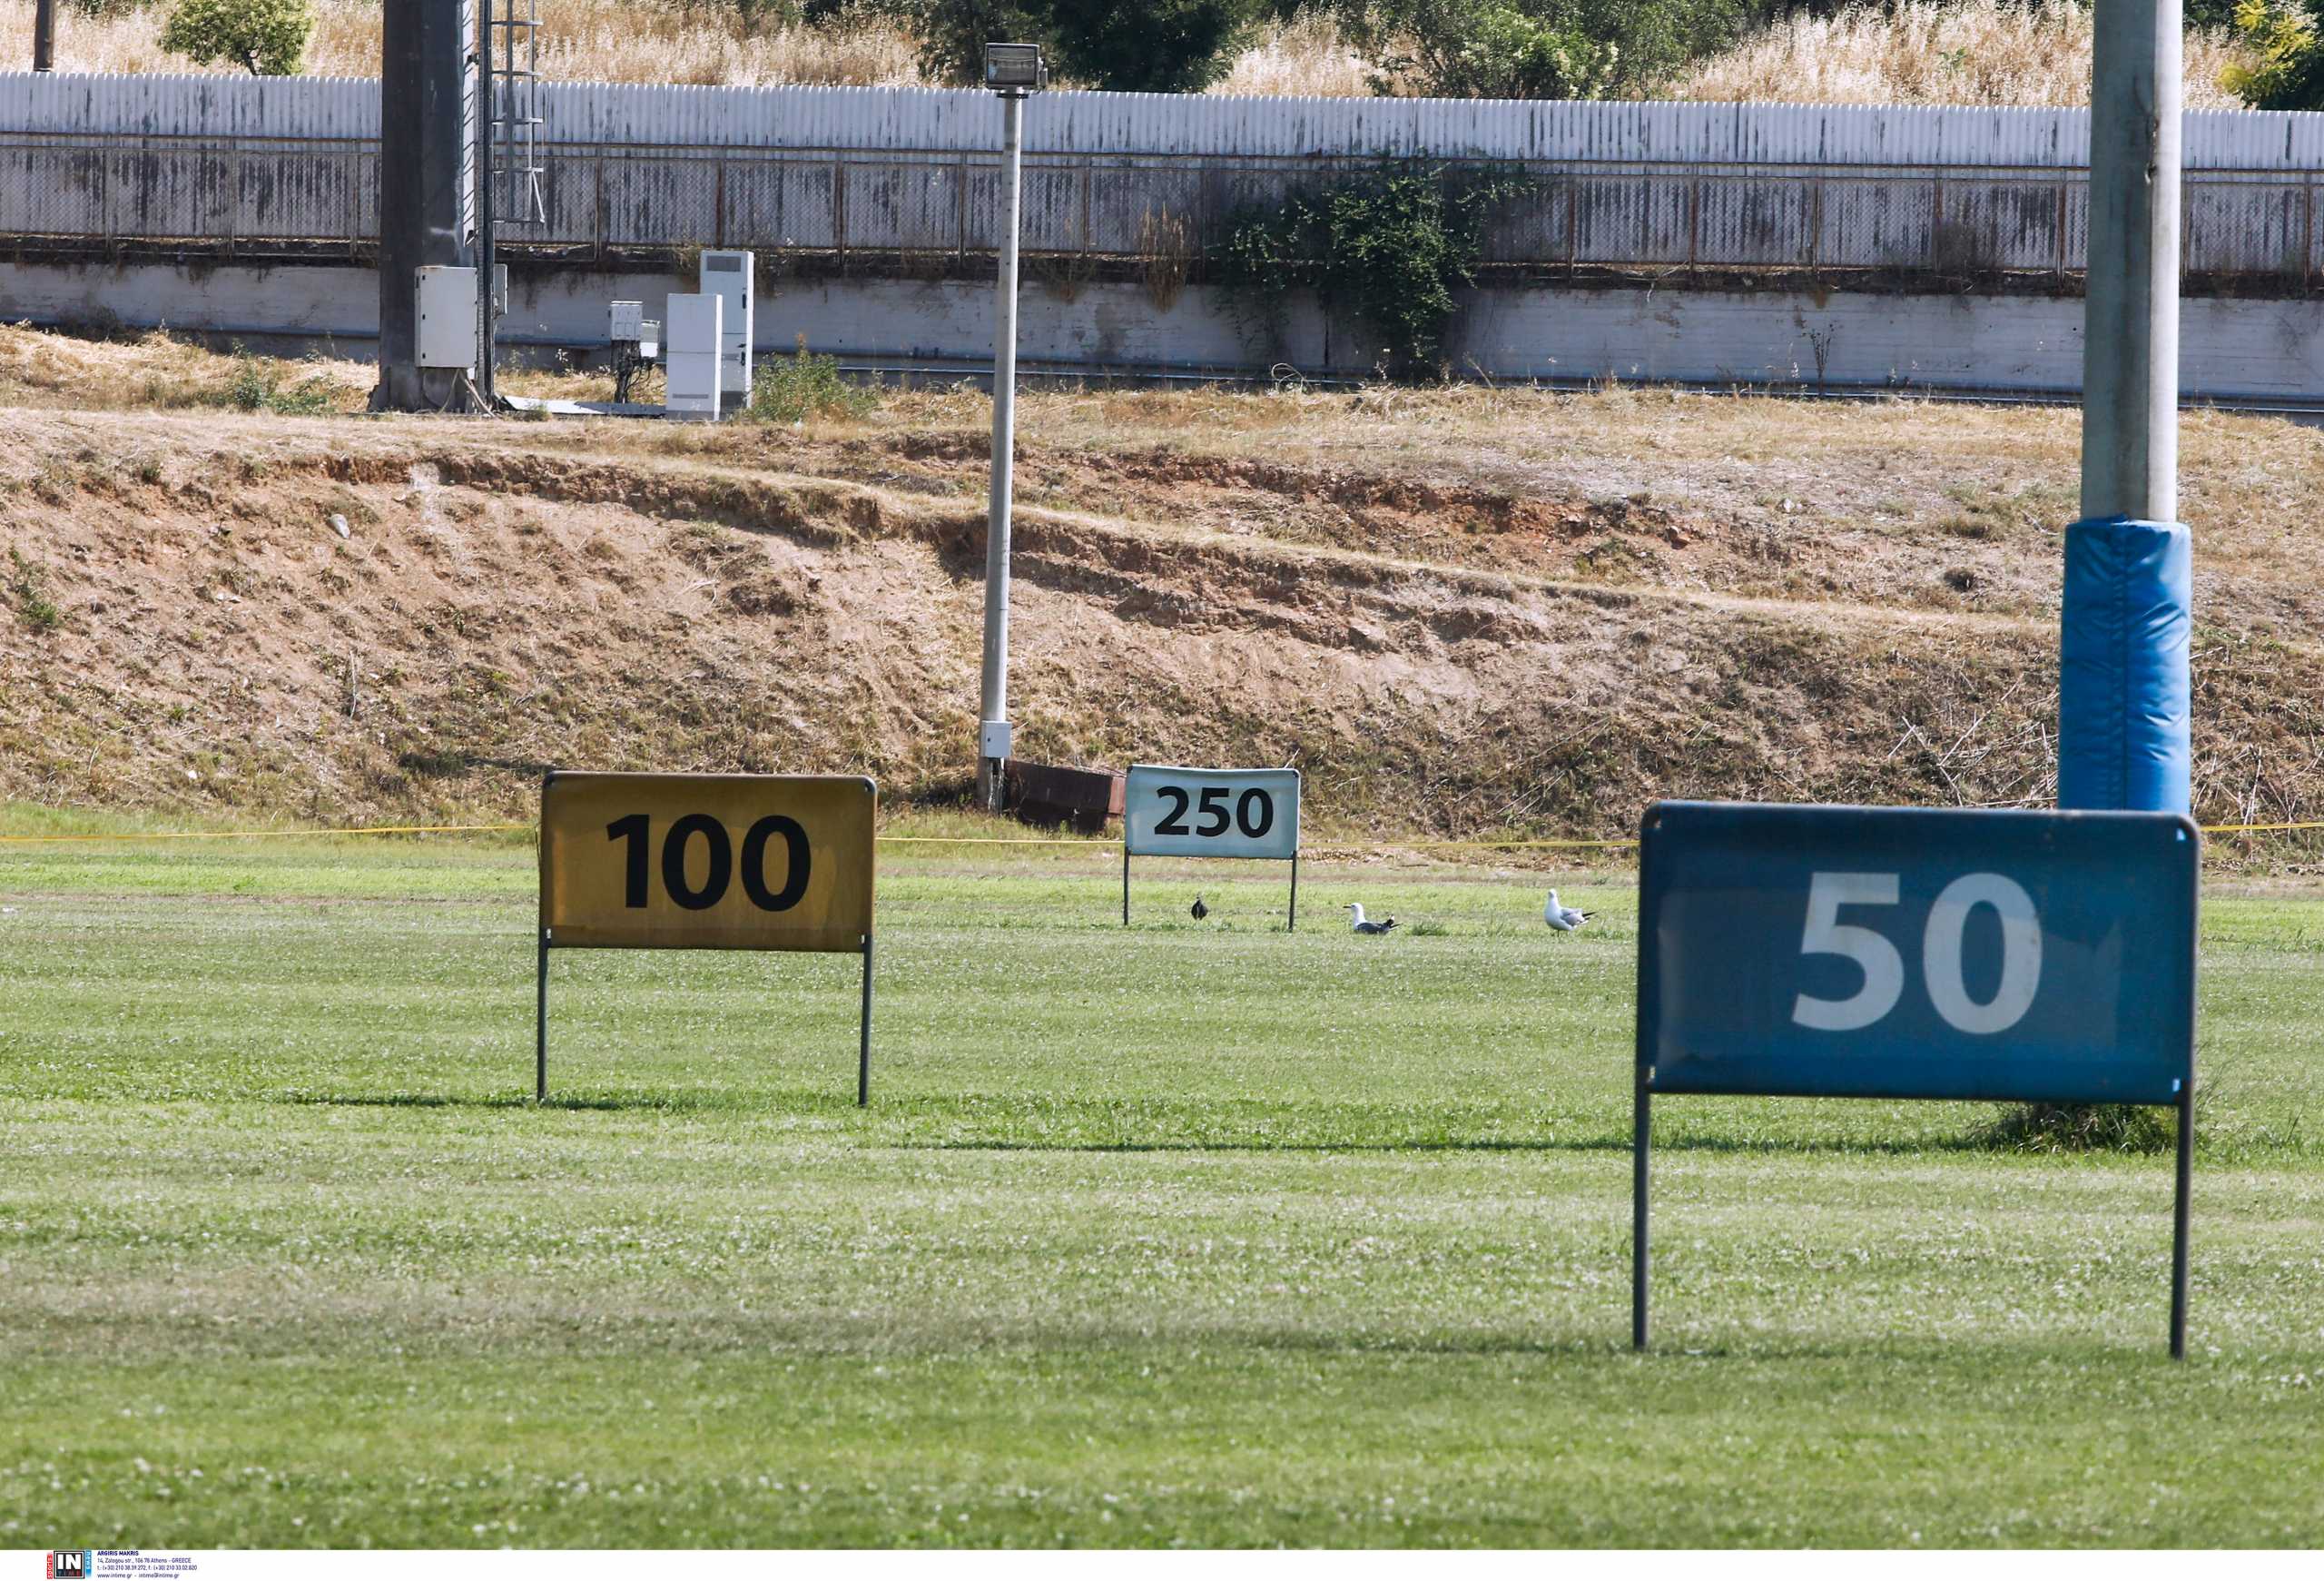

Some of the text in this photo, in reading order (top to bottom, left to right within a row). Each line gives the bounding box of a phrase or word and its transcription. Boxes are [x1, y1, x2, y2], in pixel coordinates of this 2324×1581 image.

[1154, 786, 1274, 838] 250
[606, 813, 812, 913] 100
[1790, 872, 2043, 1034] 50
